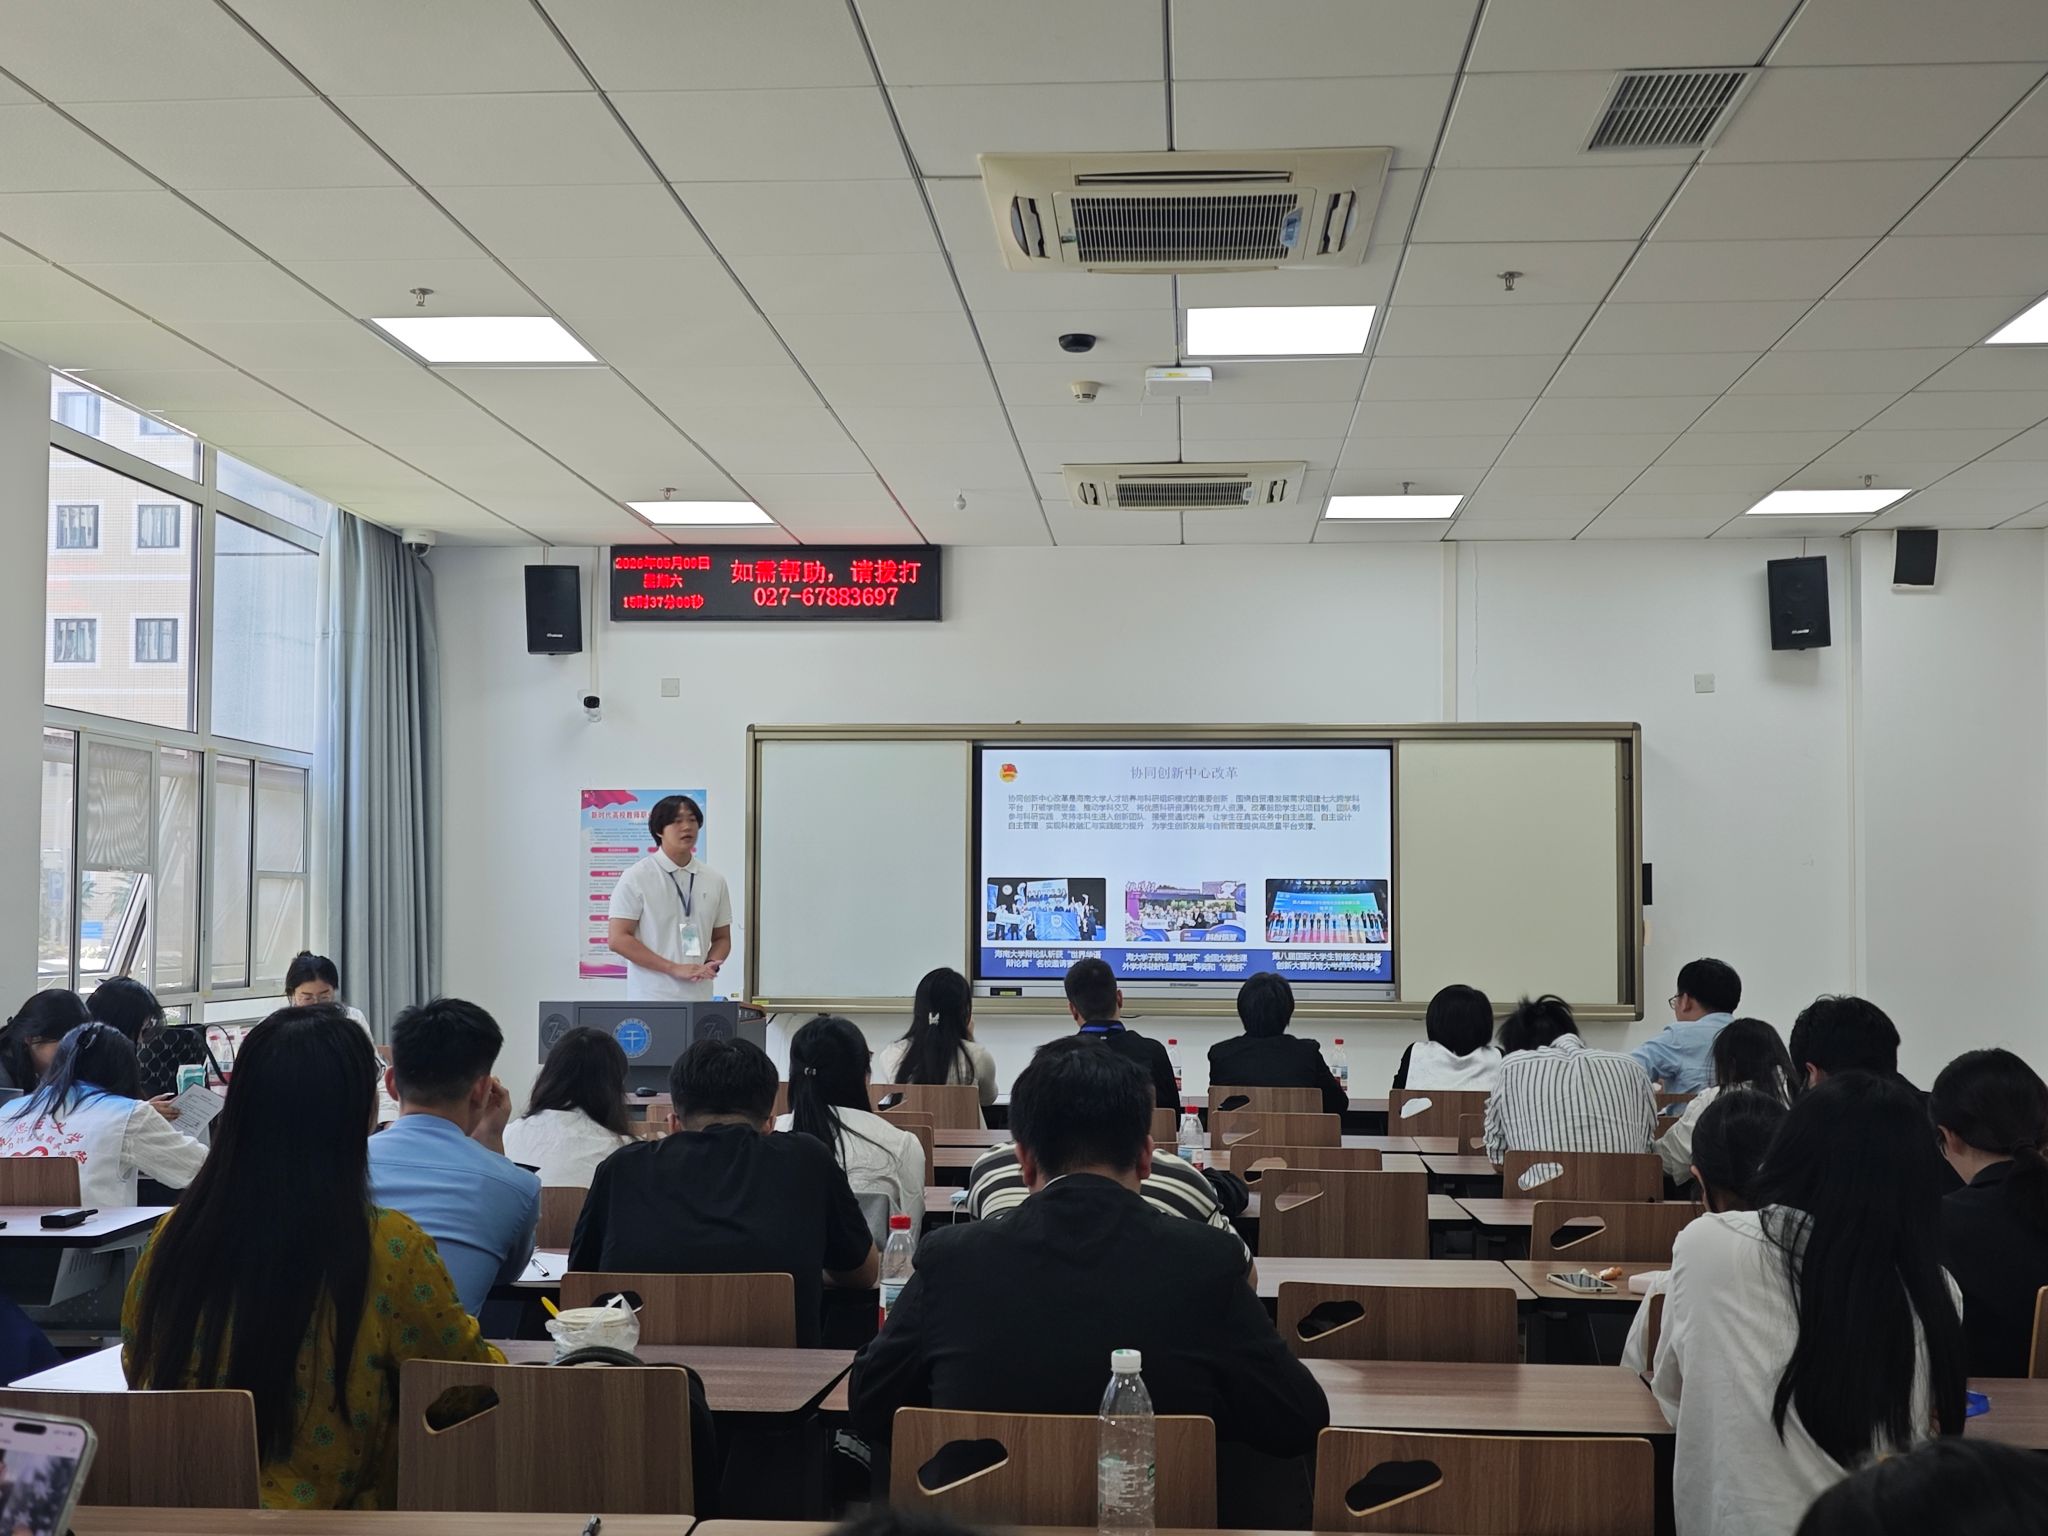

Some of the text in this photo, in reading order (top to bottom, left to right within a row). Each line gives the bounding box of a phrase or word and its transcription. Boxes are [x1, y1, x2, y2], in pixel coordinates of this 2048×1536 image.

[731, 560, 921, 584] 如需帮助，请拨打
[643, 573, 683, 588] 星期六
[754, 587, 898, 606] 027-67883697
[1131, 766, 1238, 780] 协同创新中心改革
[592, 811, 651, 819] 新时代高校教师职
